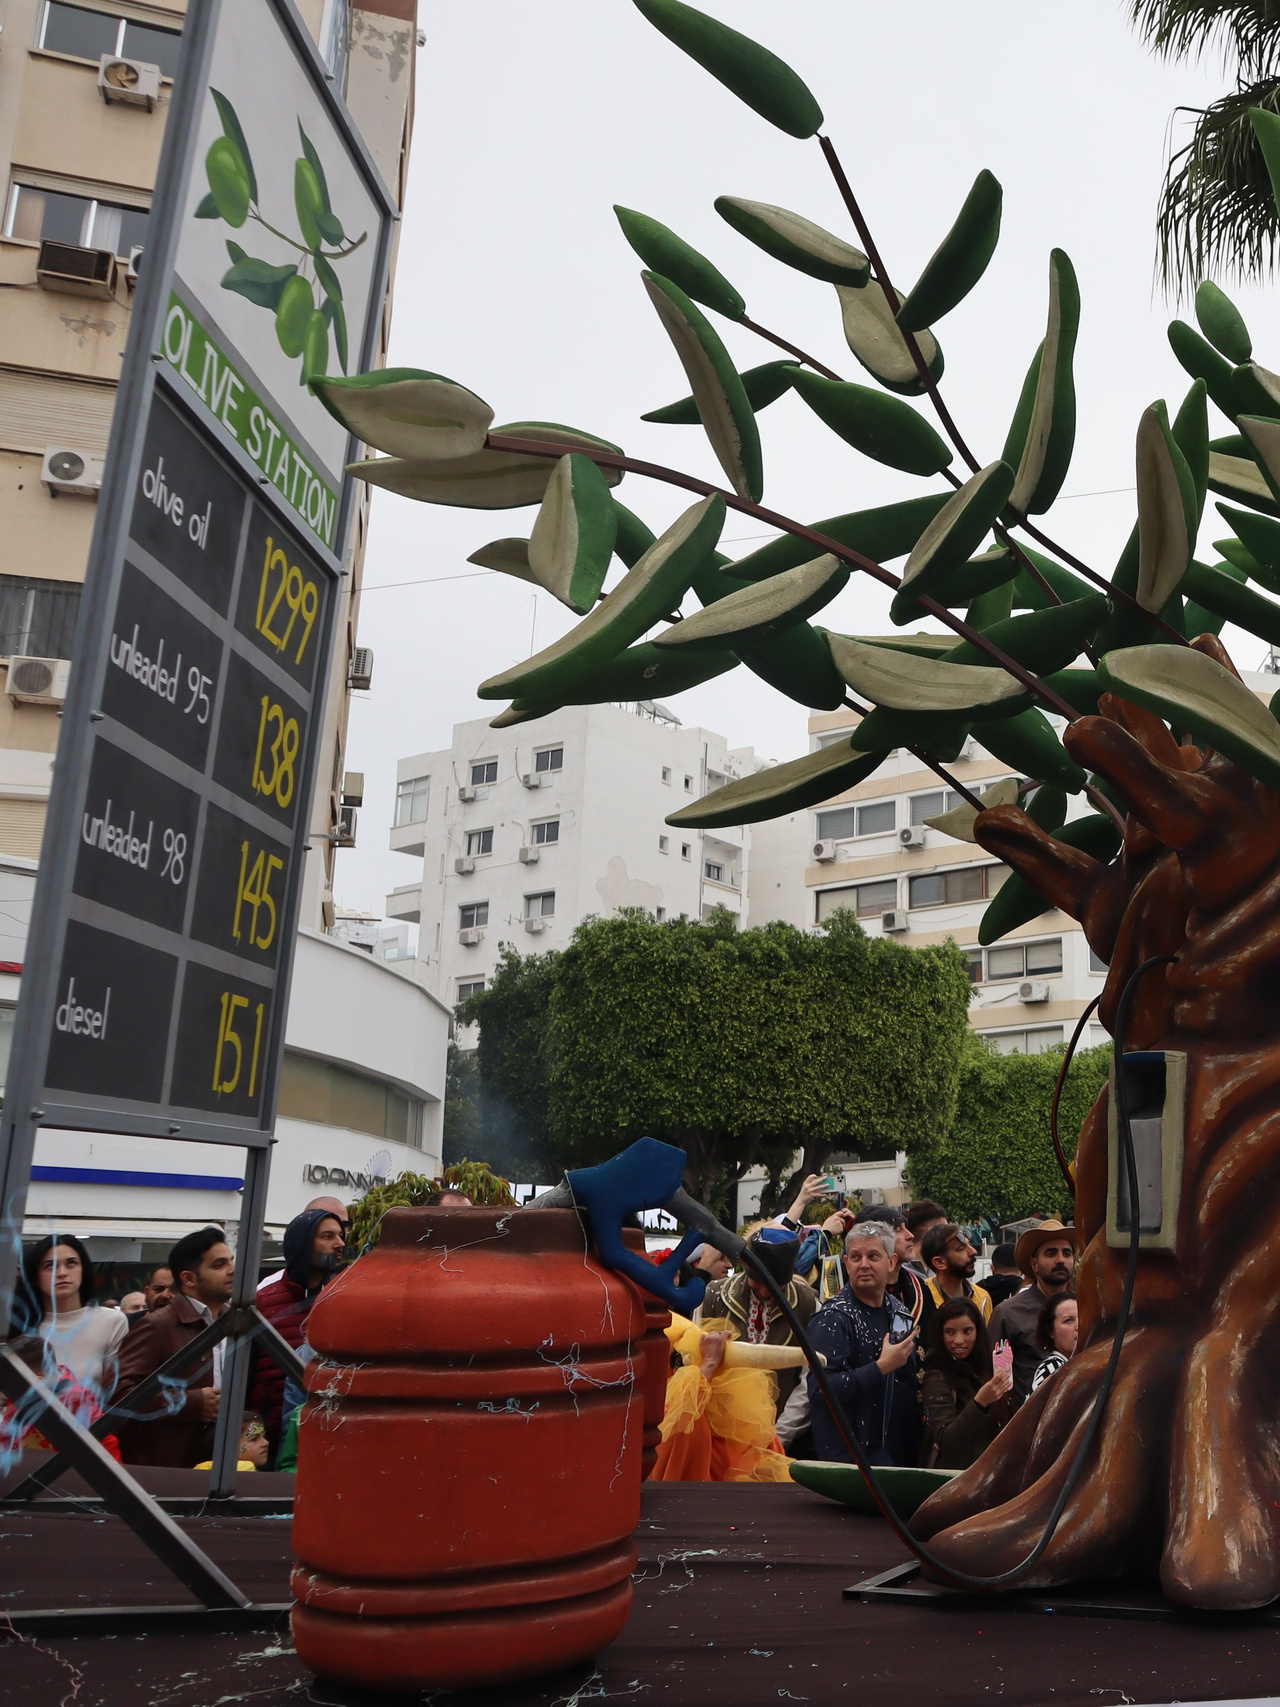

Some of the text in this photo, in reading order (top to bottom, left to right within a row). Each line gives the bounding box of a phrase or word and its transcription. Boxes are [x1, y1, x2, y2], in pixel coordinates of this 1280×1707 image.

[164, 305, 335, 547] OLIVE STATION
[142, 456, 212, 550] olive oil
[110, 623, 213, 724] unleaded 95
[82, 799, 187, 884] unleaded 98
[56, 977, 111, 1040] diesel
